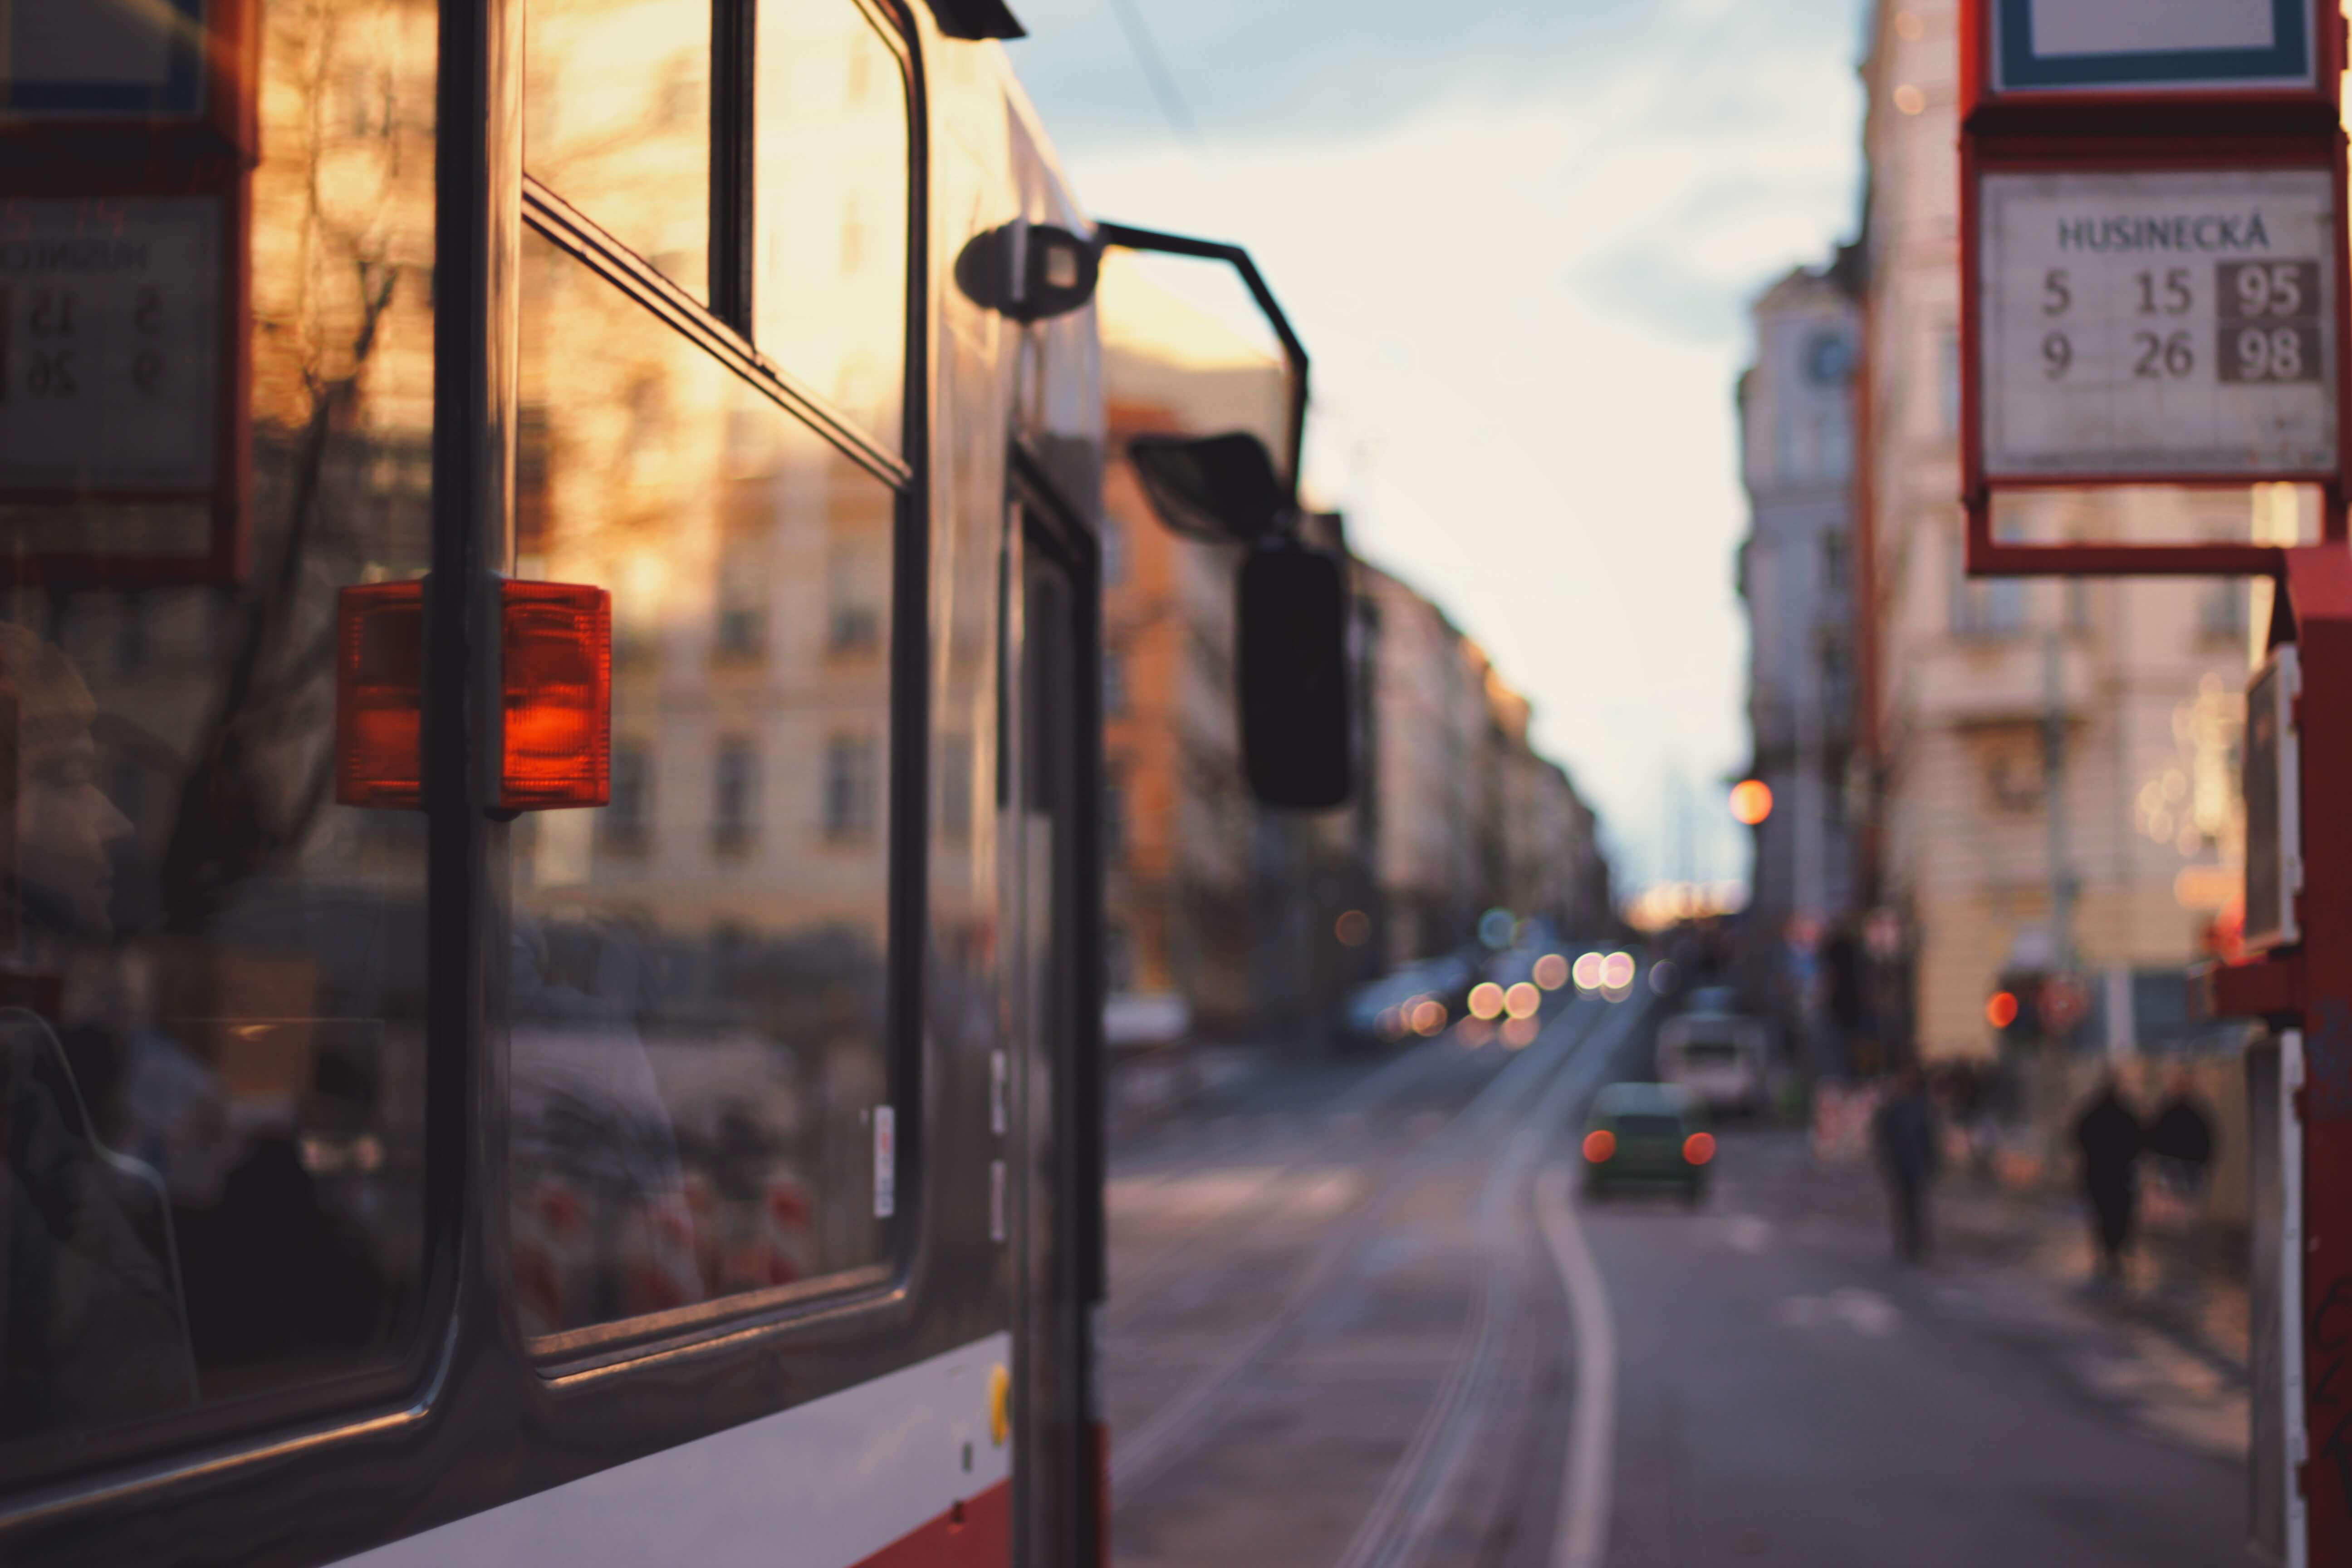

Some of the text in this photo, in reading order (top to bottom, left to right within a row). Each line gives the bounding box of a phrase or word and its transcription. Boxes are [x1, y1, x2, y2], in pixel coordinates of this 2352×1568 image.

[2058, 207, 2270, 251] HUSINECKÁ
[2042, 263, 2302, 317] 5 15 95
[2041, 327, 2303, 380] 9 26 98
